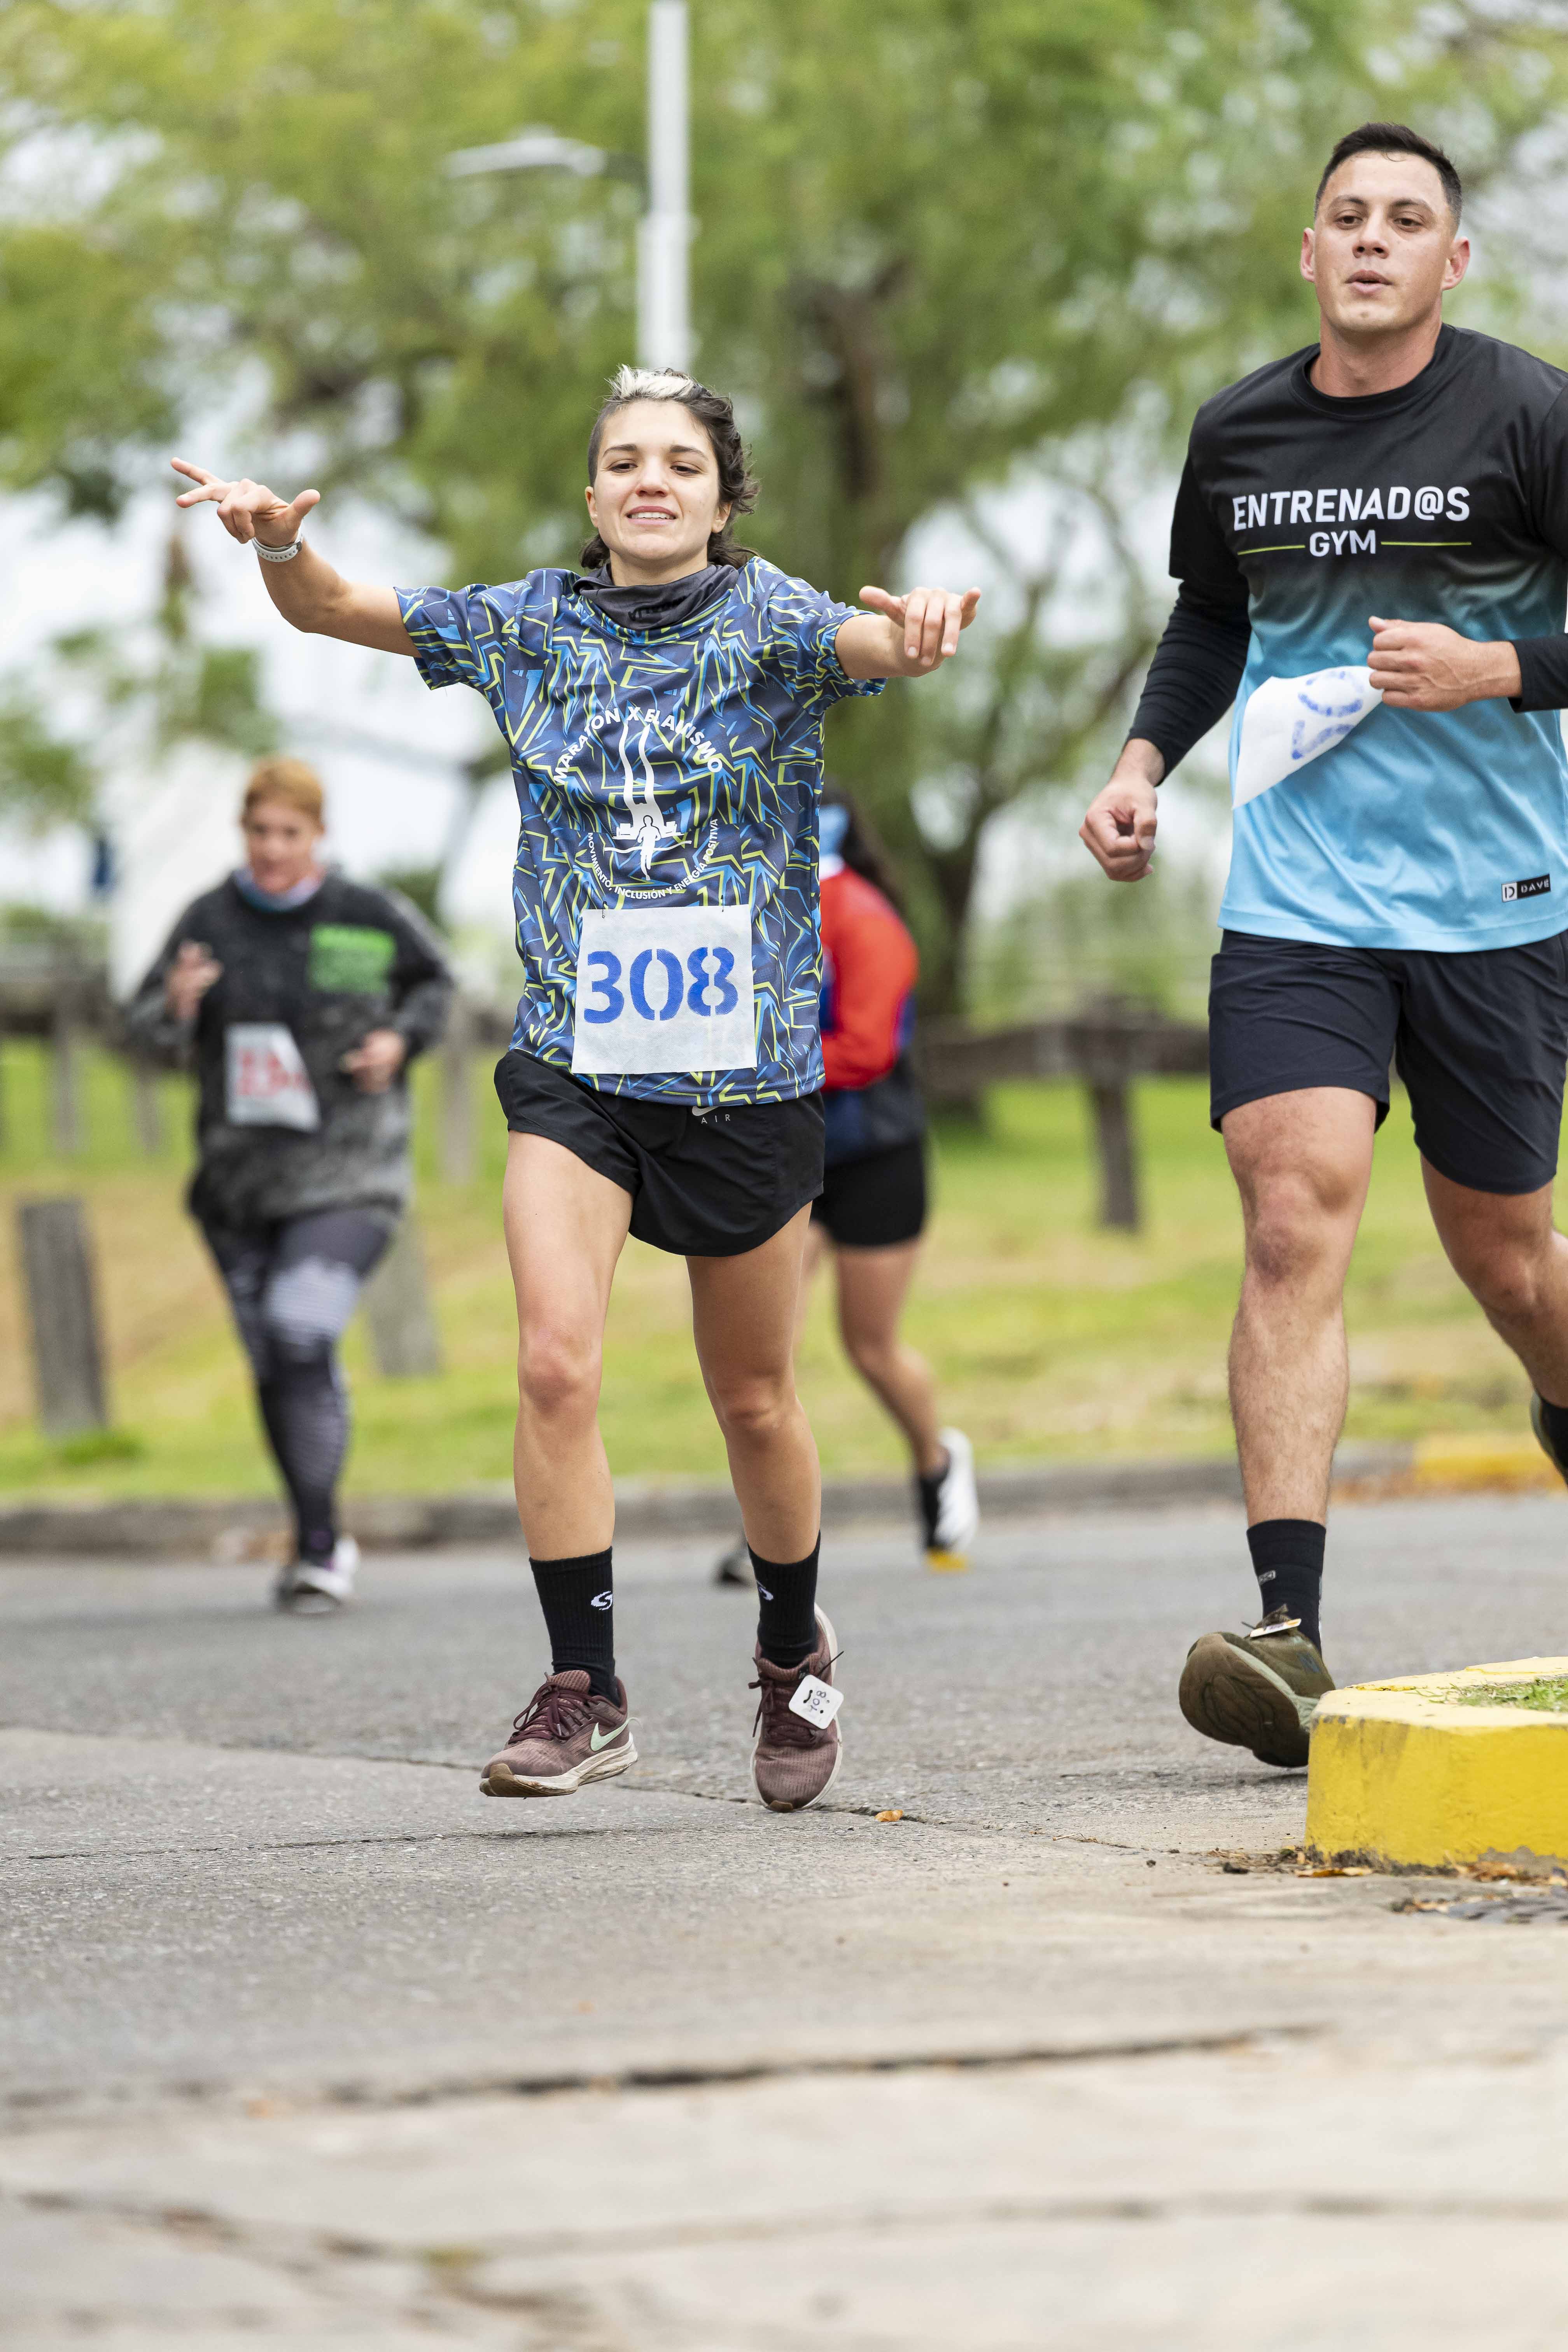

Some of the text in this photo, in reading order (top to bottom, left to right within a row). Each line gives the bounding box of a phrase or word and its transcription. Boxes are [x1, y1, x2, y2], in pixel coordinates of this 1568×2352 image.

[1232, 486, 1470, 531] ENTRENAD@S
[1309, 530, 1376, 557] GYM
[553, 707, 621, 785] MARATON
[626, 706, 641, 721] X
[644, 709, 661, 725] EL
[588, 819, 718, 900] MOVIMIENTO, INCLUSIÓN Y ENERGÍA POSITIVA
[1521, 878, 1549, 893] DAVE
[584, 946, 738, 1024] 308
[701, 1114, 731, 1124] AIR
